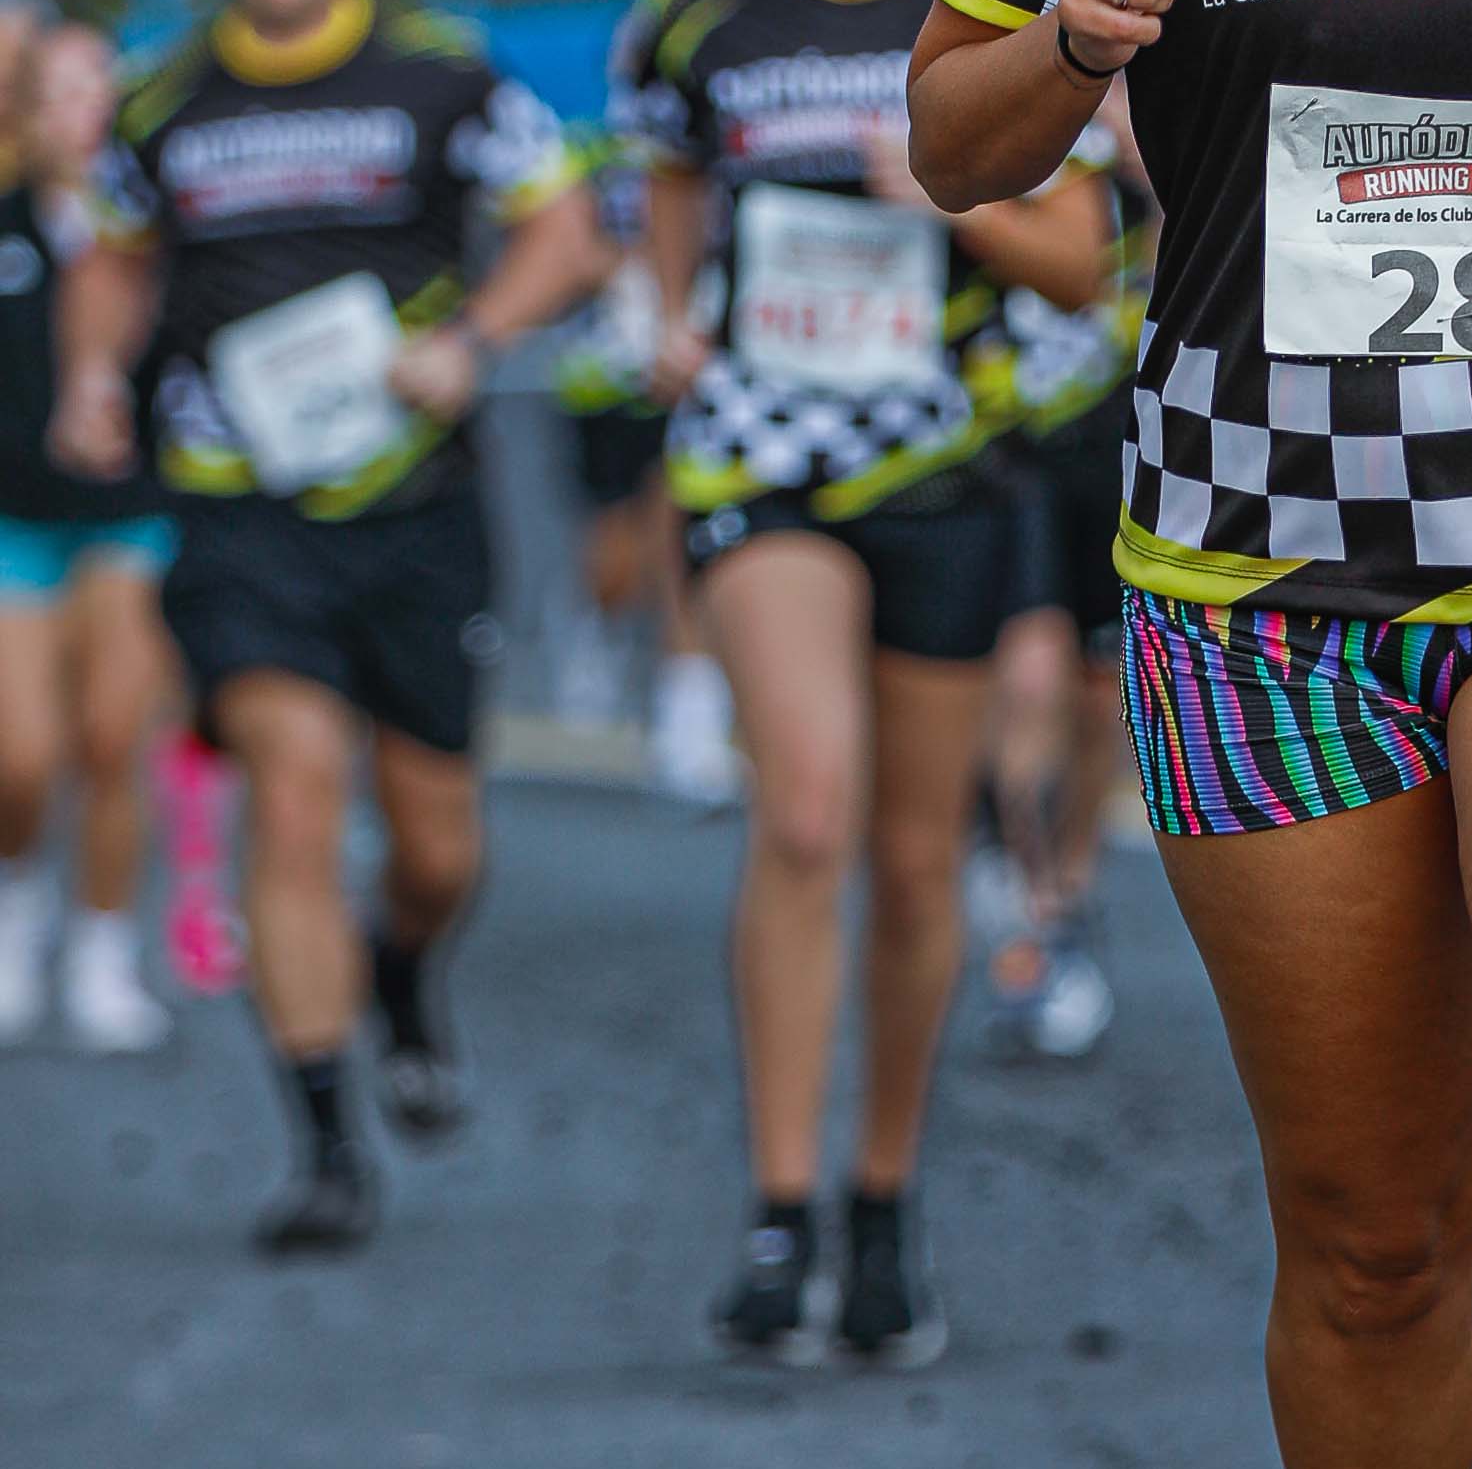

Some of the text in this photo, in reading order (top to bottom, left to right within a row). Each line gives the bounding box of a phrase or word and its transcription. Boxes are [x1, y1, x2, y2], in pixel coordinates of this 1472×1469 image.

[1364, 167, 1469, 199] RUNNING
[1316, 209, 1333, 223] La
[1336, 209, 1392, 223] Carrera
[1394, 209, 1414, 223] de
[1416, 208, 1438, 222] los
